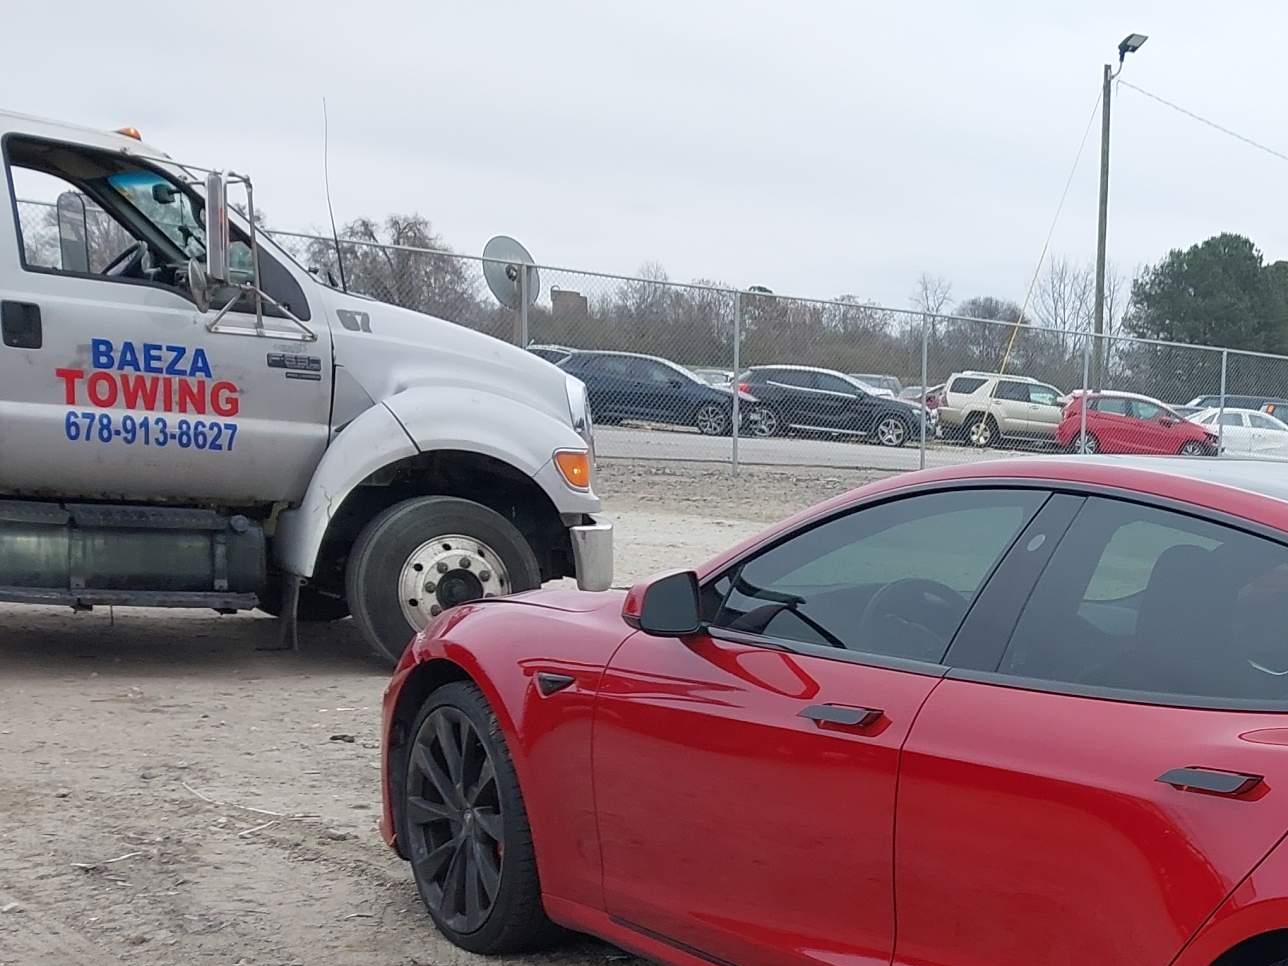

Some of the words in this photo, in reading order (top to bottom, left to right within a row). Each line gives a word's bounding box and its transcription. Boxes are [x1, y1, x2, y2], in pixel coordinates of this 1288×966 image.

[90, 337, 213, 379] BAEZA
[56, 368, 240, 417] TOWING
[65, 410, 239, 452] 678-913-8627
